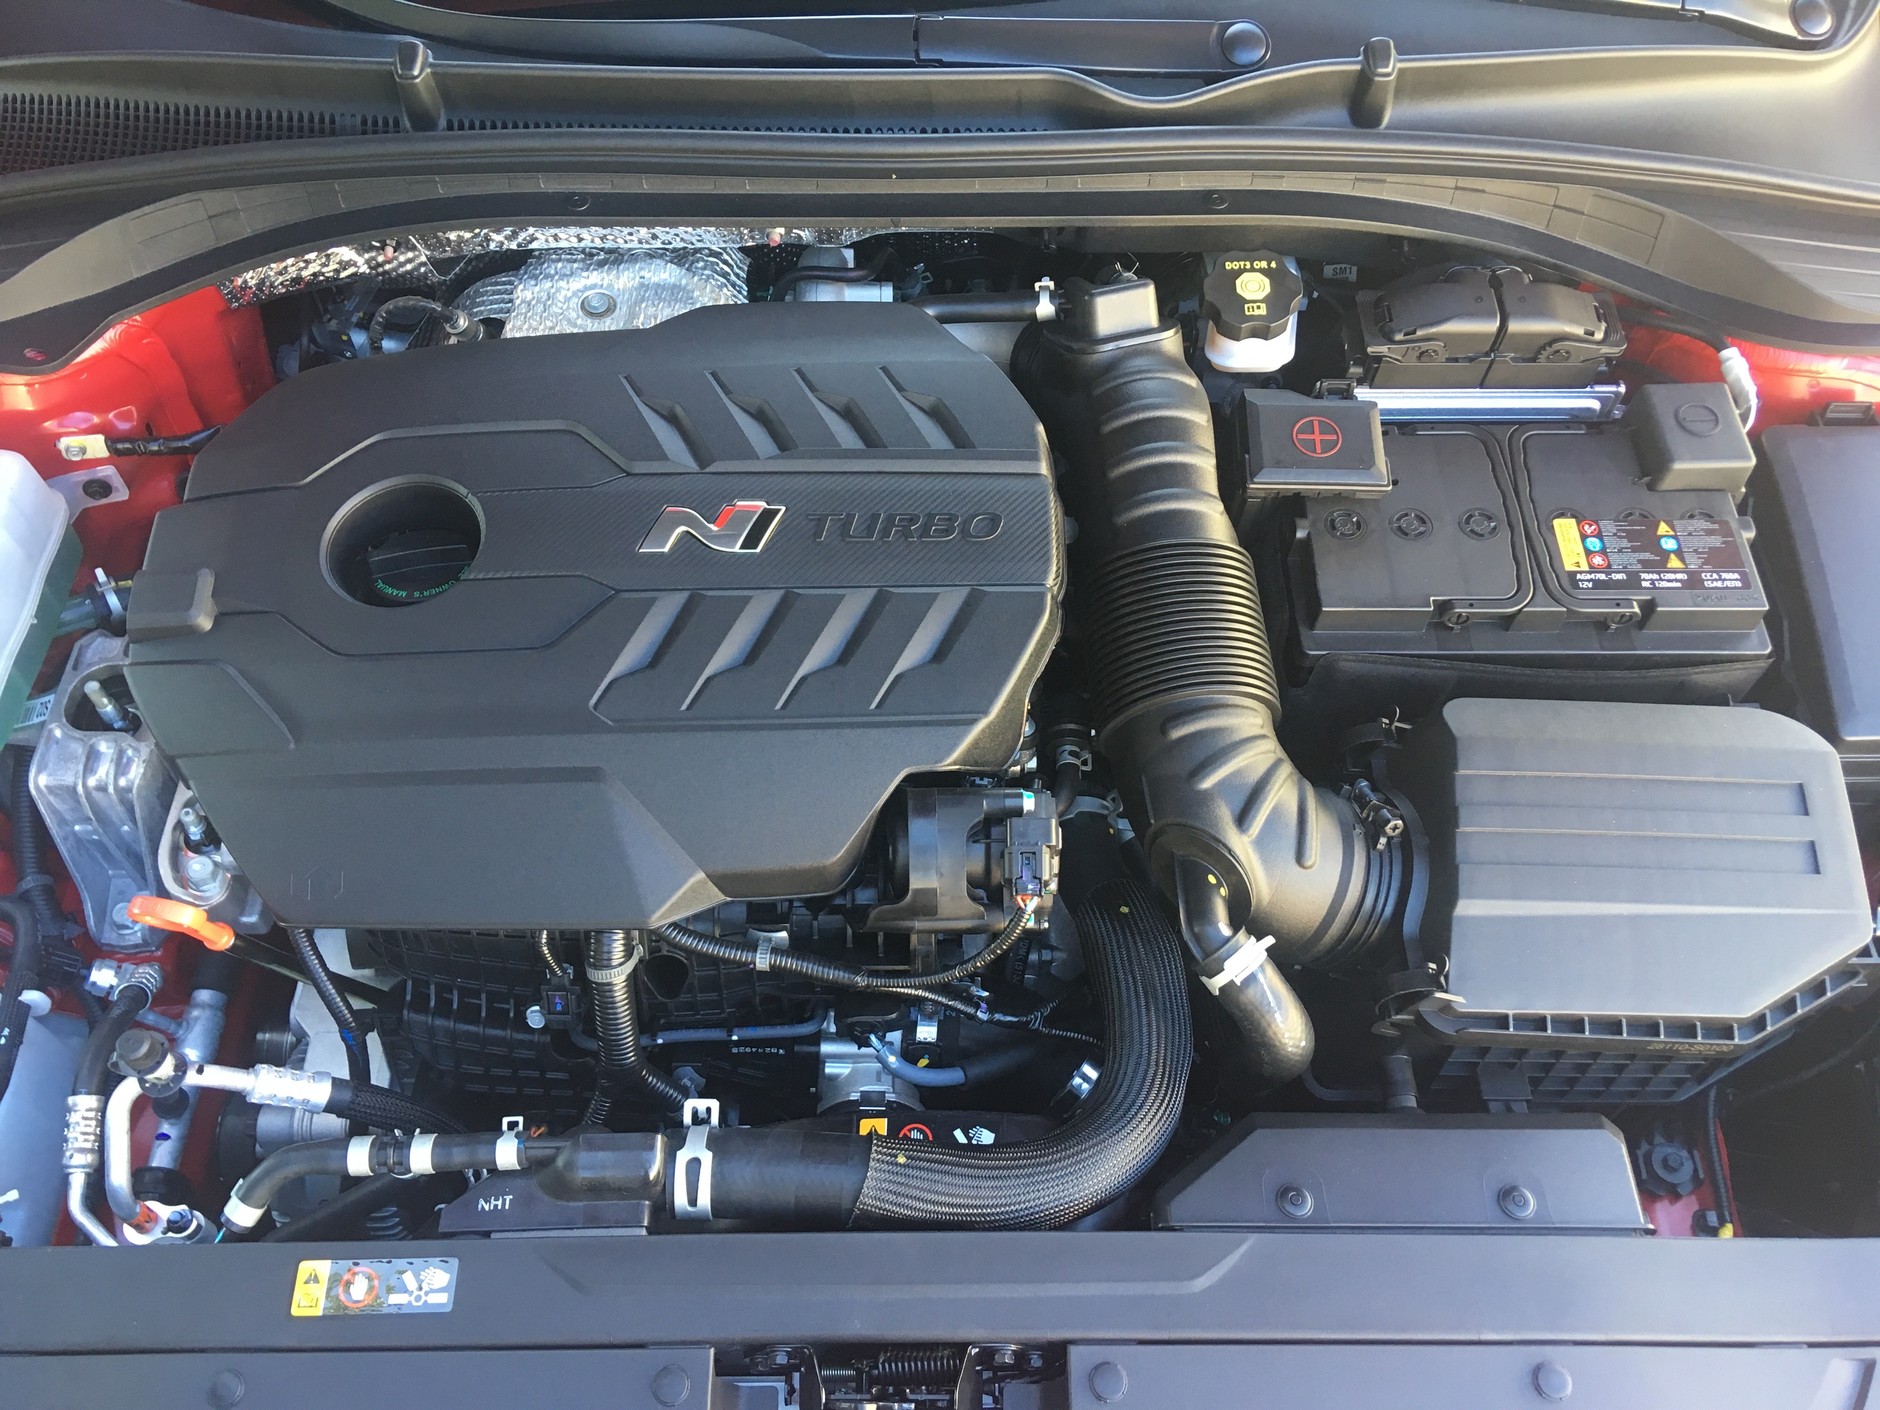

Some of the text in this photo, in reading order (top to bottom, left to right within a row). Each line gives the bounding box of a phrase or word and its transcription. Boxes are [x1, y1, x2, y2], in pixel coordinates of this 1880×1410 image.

[1225, 260, 1277, 270] DOT3 OR 4
[806, 511, 1005, 542] TURBO
[1639, 572, 1688, 580] 70Ah (20HR)
[1701, 572, 1741, 580] CCA 760A
[374, 579, 457, 598] OWNER'S MANUAL
[477, 1195, 514, 1212] NHT
